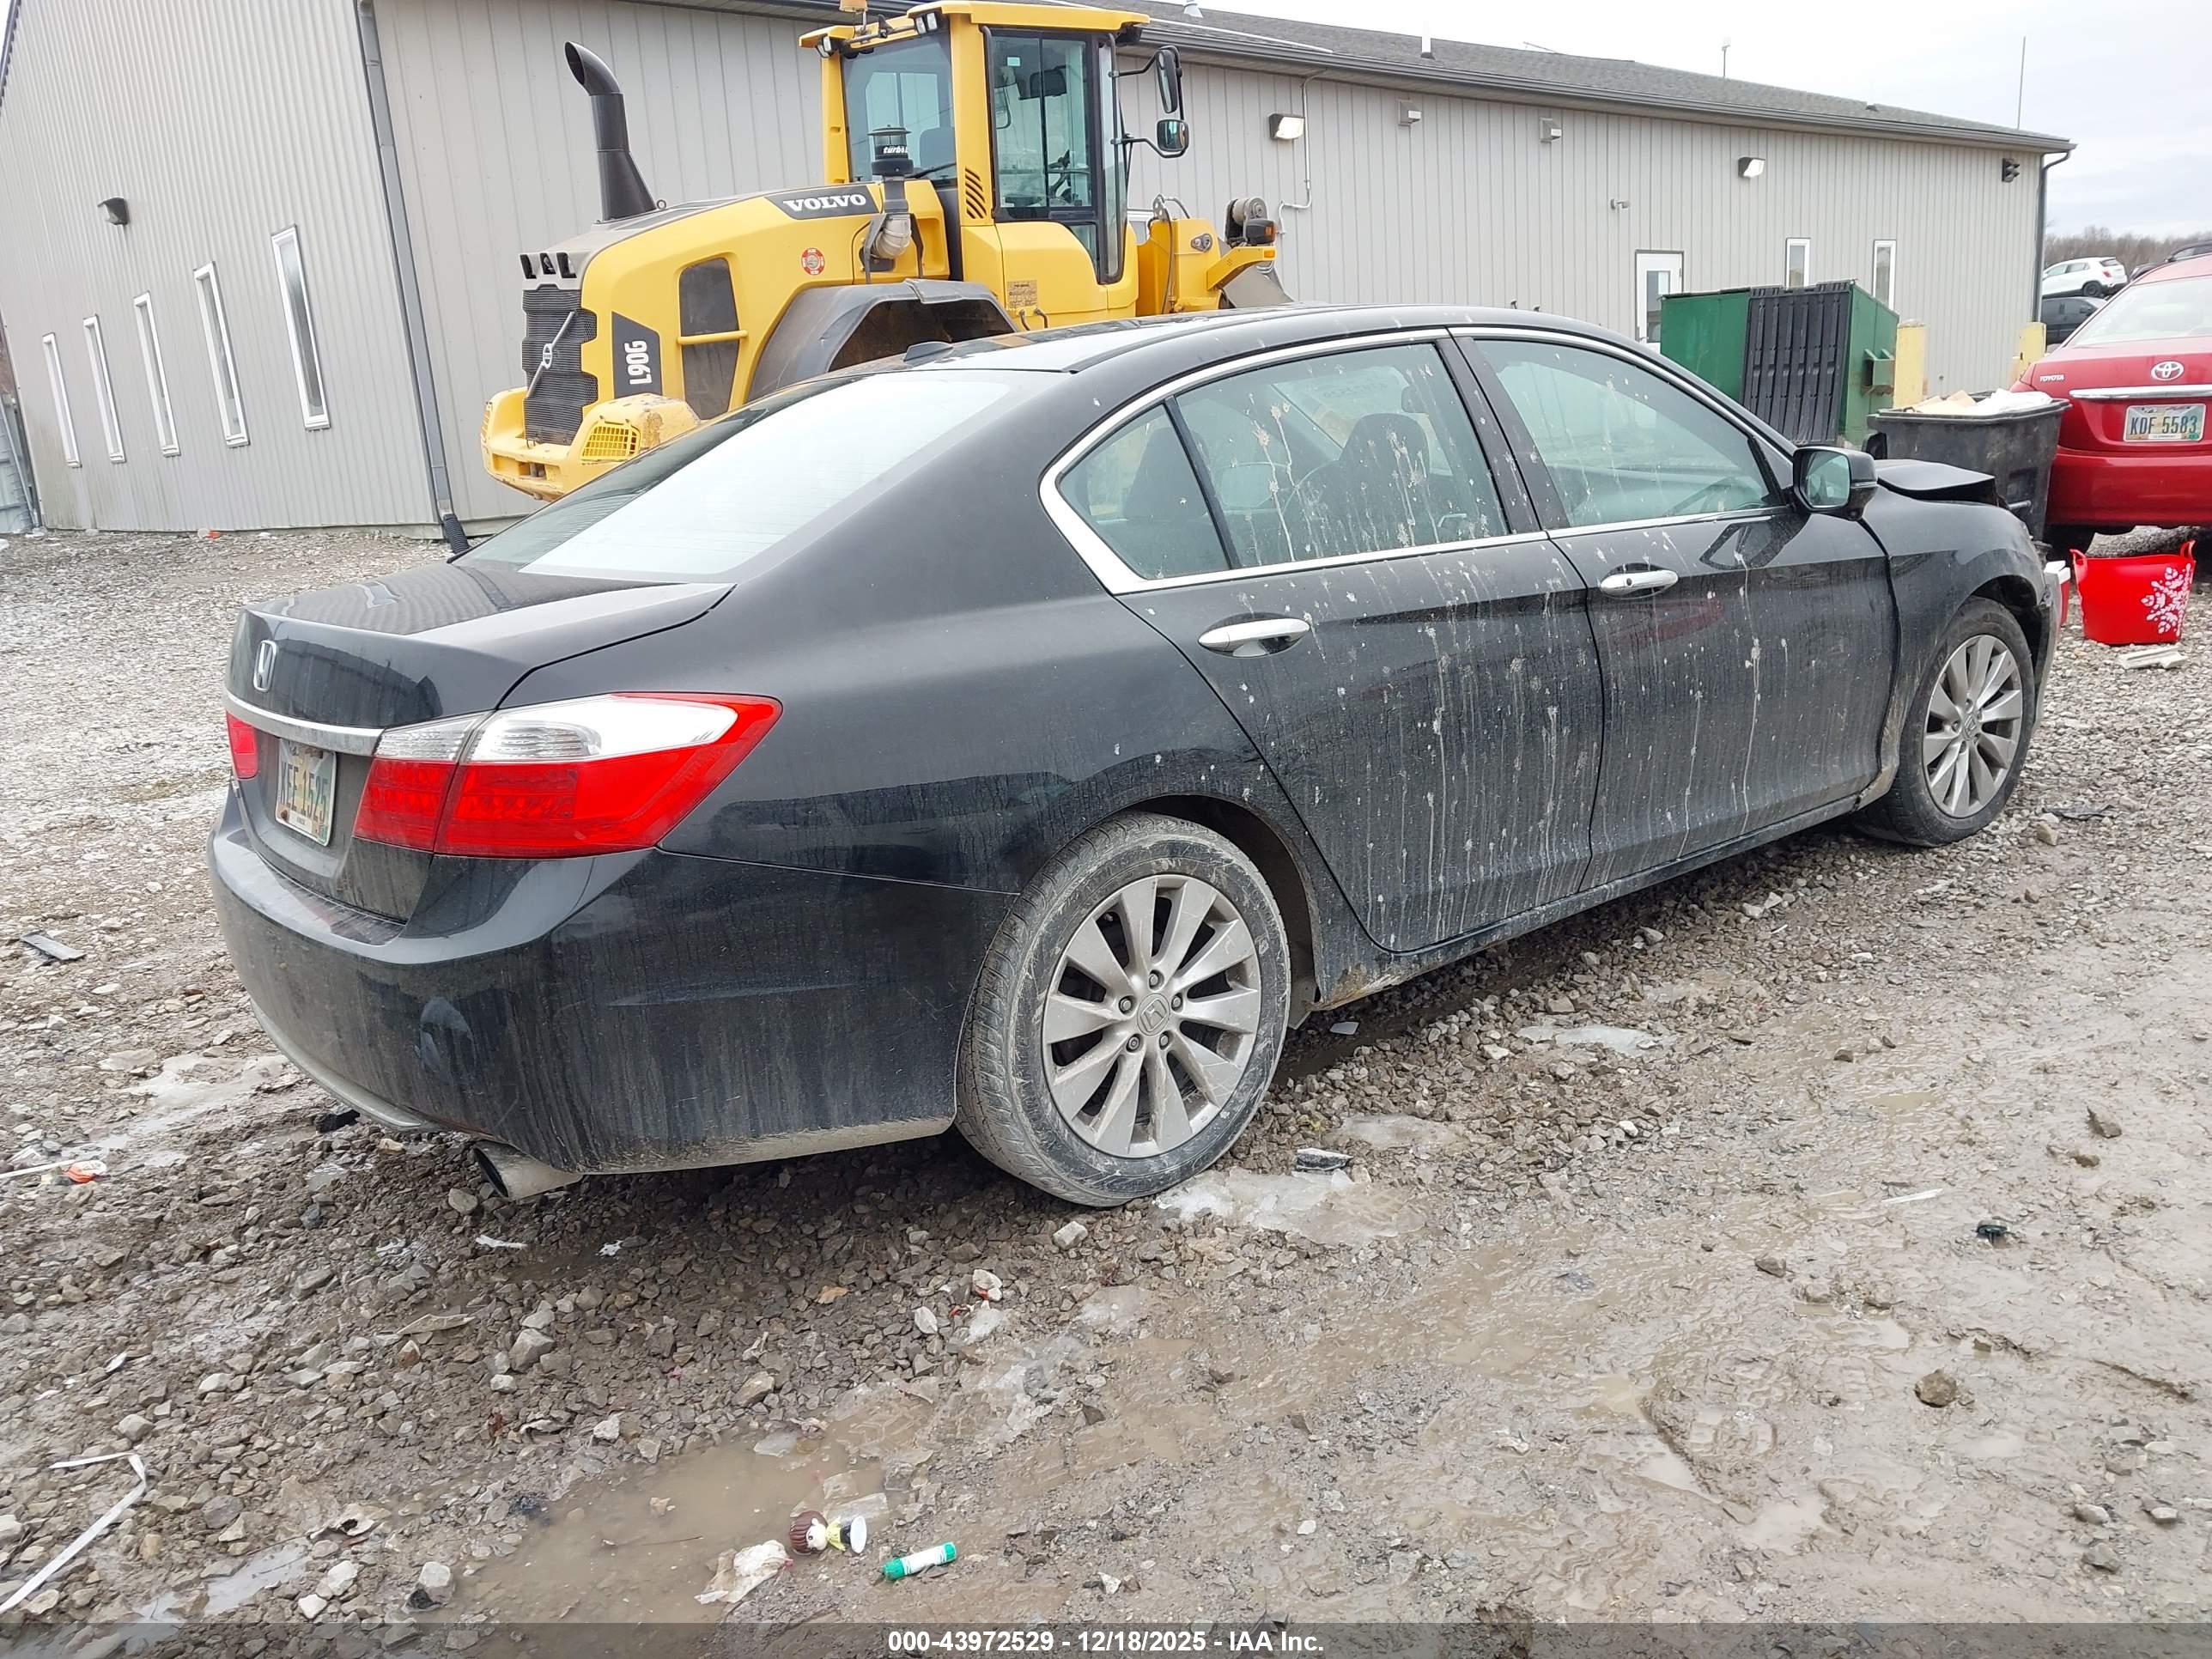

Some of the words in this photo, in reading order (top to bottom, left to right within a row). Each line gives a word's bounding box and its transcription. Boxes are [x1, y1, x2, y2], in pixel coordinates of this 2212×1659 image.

[782, 194, 866, 211] VOLVO
[624, 340, 653, 385] L90G
[2130, 416, 2156, 435] KDF
[2161, 415, 2198, 434] 5583
